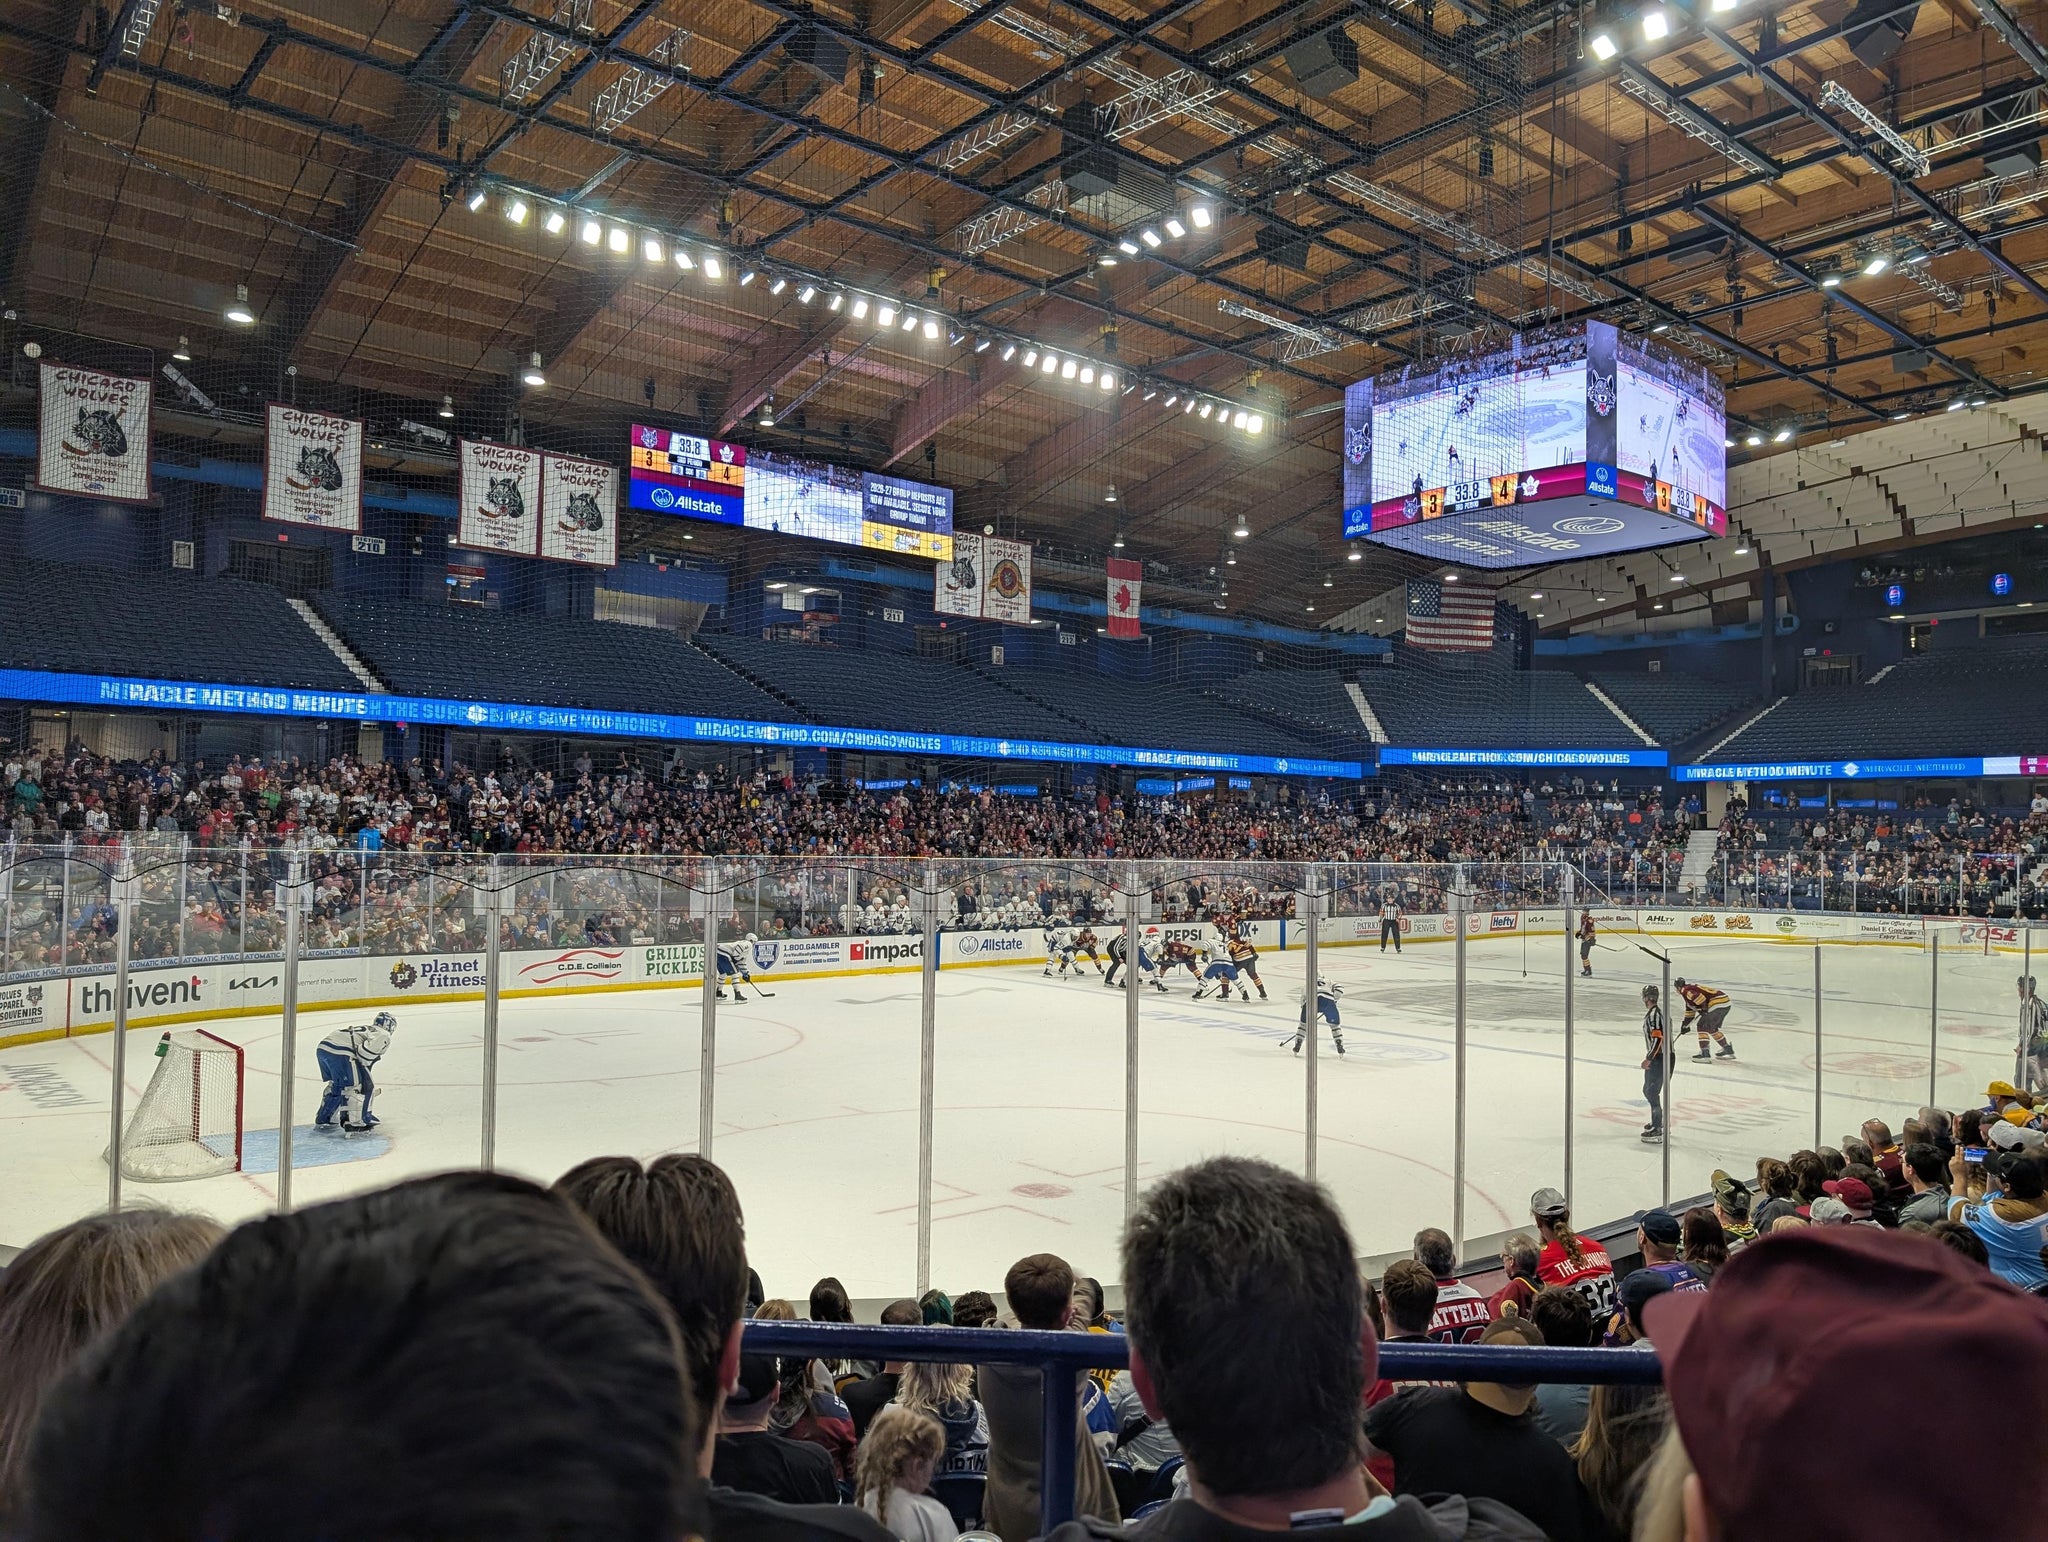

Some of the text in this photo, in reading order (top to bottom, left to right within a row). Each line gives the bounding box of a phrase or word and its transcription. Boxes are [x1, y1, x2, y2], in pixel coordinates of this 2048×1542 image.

[56, 371, 135, 392] CHICAGO
[64, 385, 130, 406] WOLVES
[283, 411, 350, 431] CHICAGO
[288, 425, 344, 444] WOLVES
[680, 438, 701, 455] 33.8
[60, 452, 128, 469] Central Division
[473, 446, 531, 463] CHICAGO
[646, 451, 653, 466] 3
[71, 463, 118, 476] Champions
[478, 458, 527, 475] WOLVES
[555, 461, 609, 477] CHICAGO
[723, 466, 730, 481] 4
[560, 473, 606, 488] WOLVES
[1588, 481, 1614, 495] Allstate
[285, 489, 343, 502] Central Division
[1455, 482, 1479, 501] 33.8
[1500, 480, 1507, 499] 4
[1661, 487, 1667, 507] 3
[294, 498, 334, 509] Champions
[675, 495, 722, 515] Allstate
[1429, 494, 1436, 513] 3
[1677, 489, 1690, 509] 33.8
[294, 506, 332, 516] 2017-2018
[1699, 501, 1703, 520] 4
[1345, 522, 1369, 535] Allstate
[955, 532, 980, 544] ICAGO
[1461, 520, 1582, 555] Allstate
[100, 681, 197, 704] MIRACLE
[201, 688, 288, 710] METHOD
[1687, 766, 1735, 778] MIRACLE
[1736, 766, 1784, 777] METHOD
[1414, 924, 1436, 932] DENVER
[1492, 915, 1514, 929] Hefty
[1164, 929, 1202, 941] PEPSI
[783, 942, 840, 951] 1.800.GAMBLER
[864, 938, 924, 962] impact
[980, 937, 1023, 951] Allstate
[183, 953, 239, 964] ATOMATIC HVAC
[341, 948, 359, 956] HVAC
[646, 947, 705, 961] GRILLO'S
[104, 964, 117, 972] HVA
[161, 958, 178, 966] HVAC
[421, 958, 479, 975] planet
[557, 962, 622, 971] C.D.E. Collision
[646, 961, 704, 976] PICKLES
[397, 971, 410, 982] pf
[428, 971, 487, 988] fitness
[0, 990, 22, 1000] OLVES
[1554, 1258, 1579, 1279] THE
[1576, 1274, 1616, 1311] 32
[1428, 1302, 1490, 1329] ATTELUS
